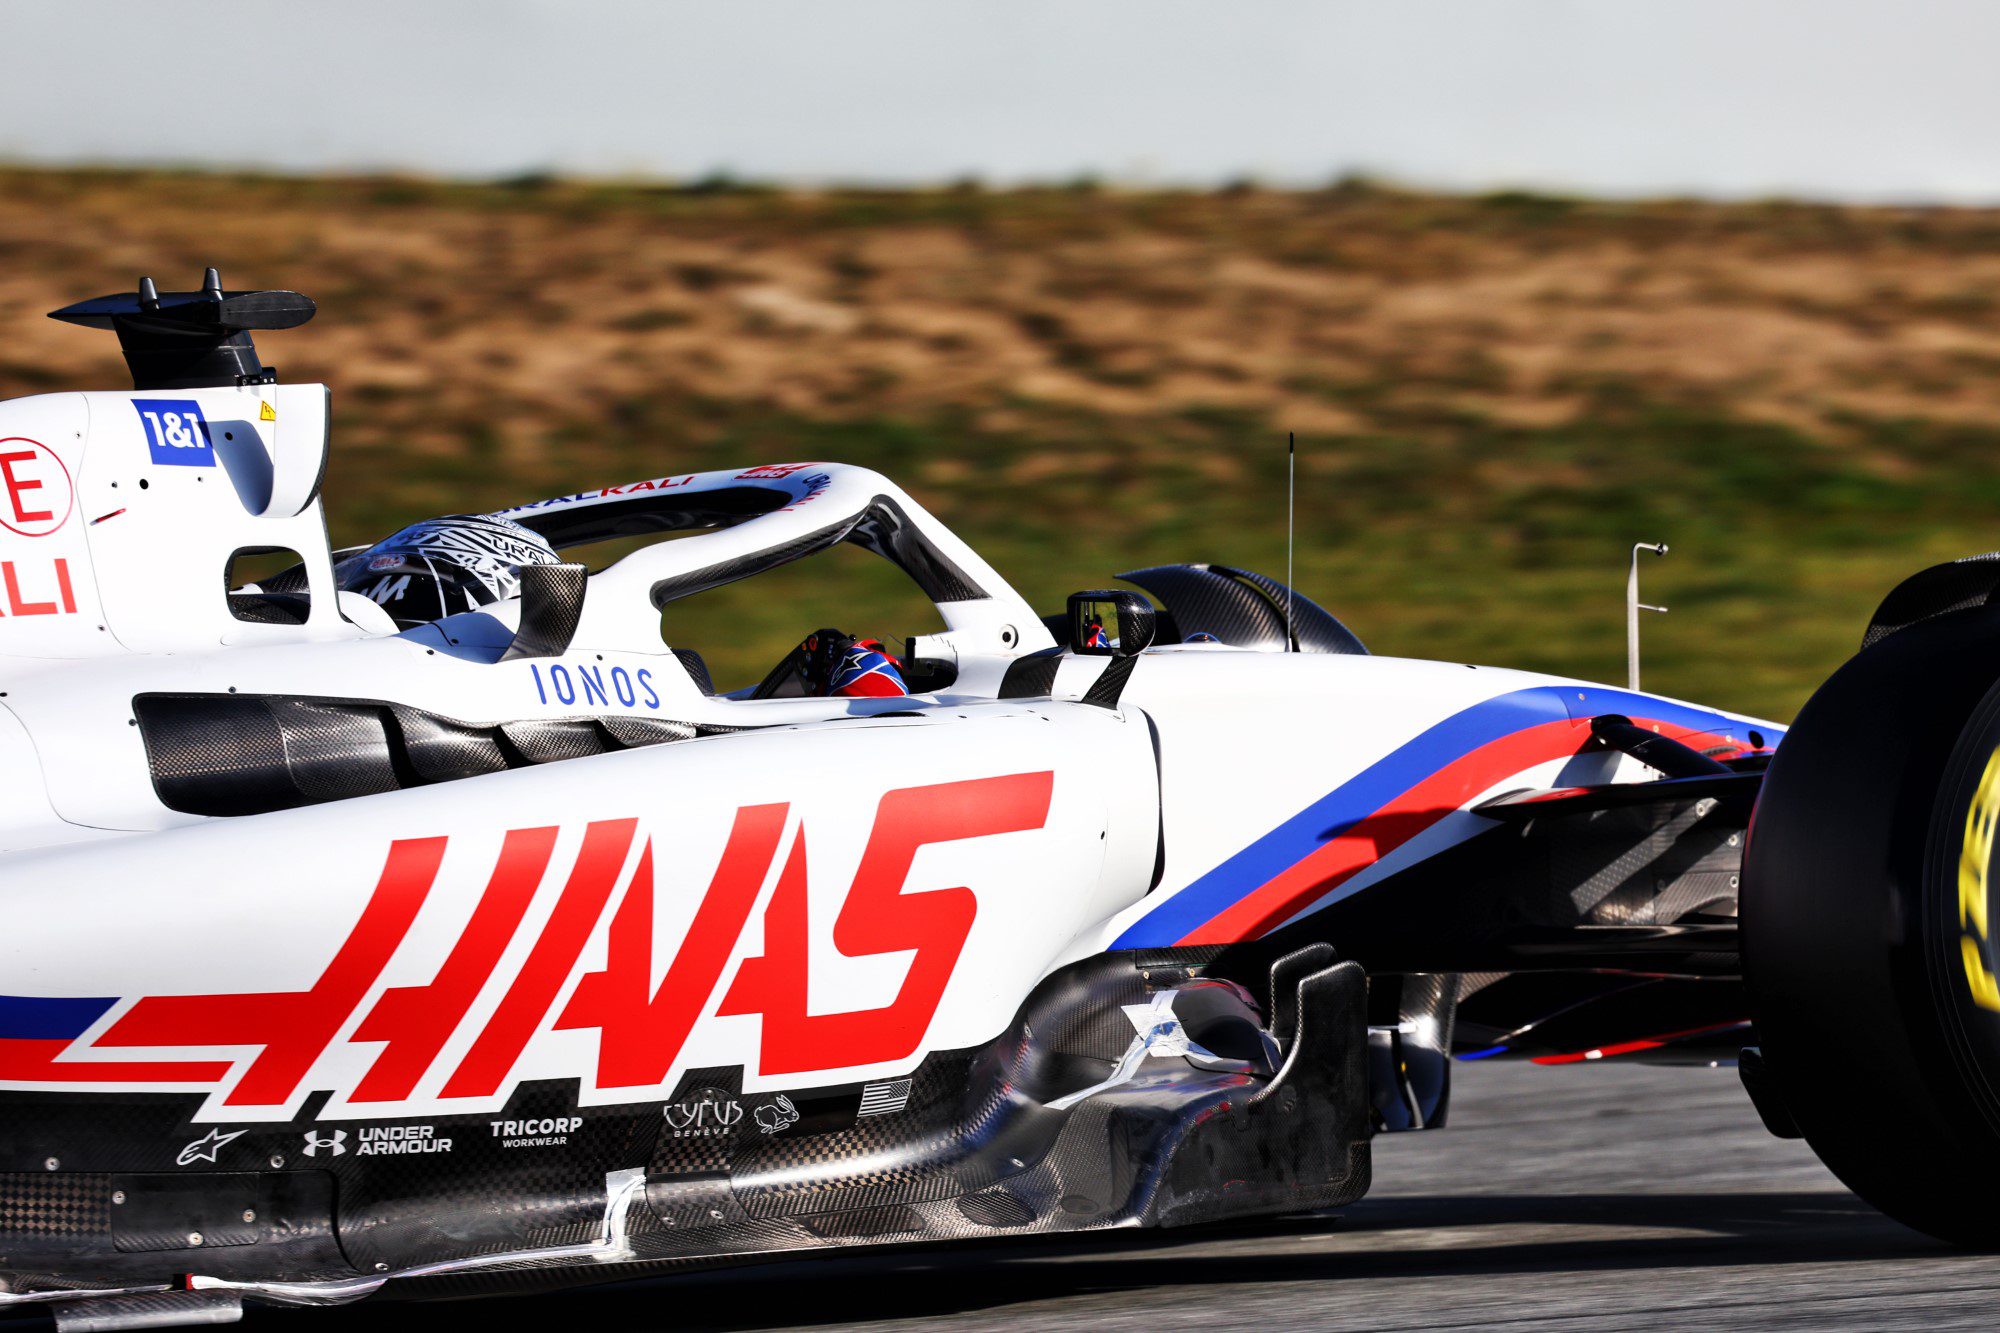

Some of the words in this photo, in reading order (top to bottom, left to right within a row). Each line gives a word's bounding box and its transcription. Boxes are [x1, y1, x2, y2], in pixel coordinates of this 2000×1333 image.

[143, 411, 206, 448] 1&1
[0, 558, 77, 617] LI
[532, 663, 660, 710] IONOS
[91, 770, 1054, 1106] HAAS
[358, 1126, 434, 1141] UNDER
[490, 1117, 583, 1137] TRICORP
[355, 1138, 452, 1156] ARMOUR
[502, 1136, 567, 1148] WORKWEAR
